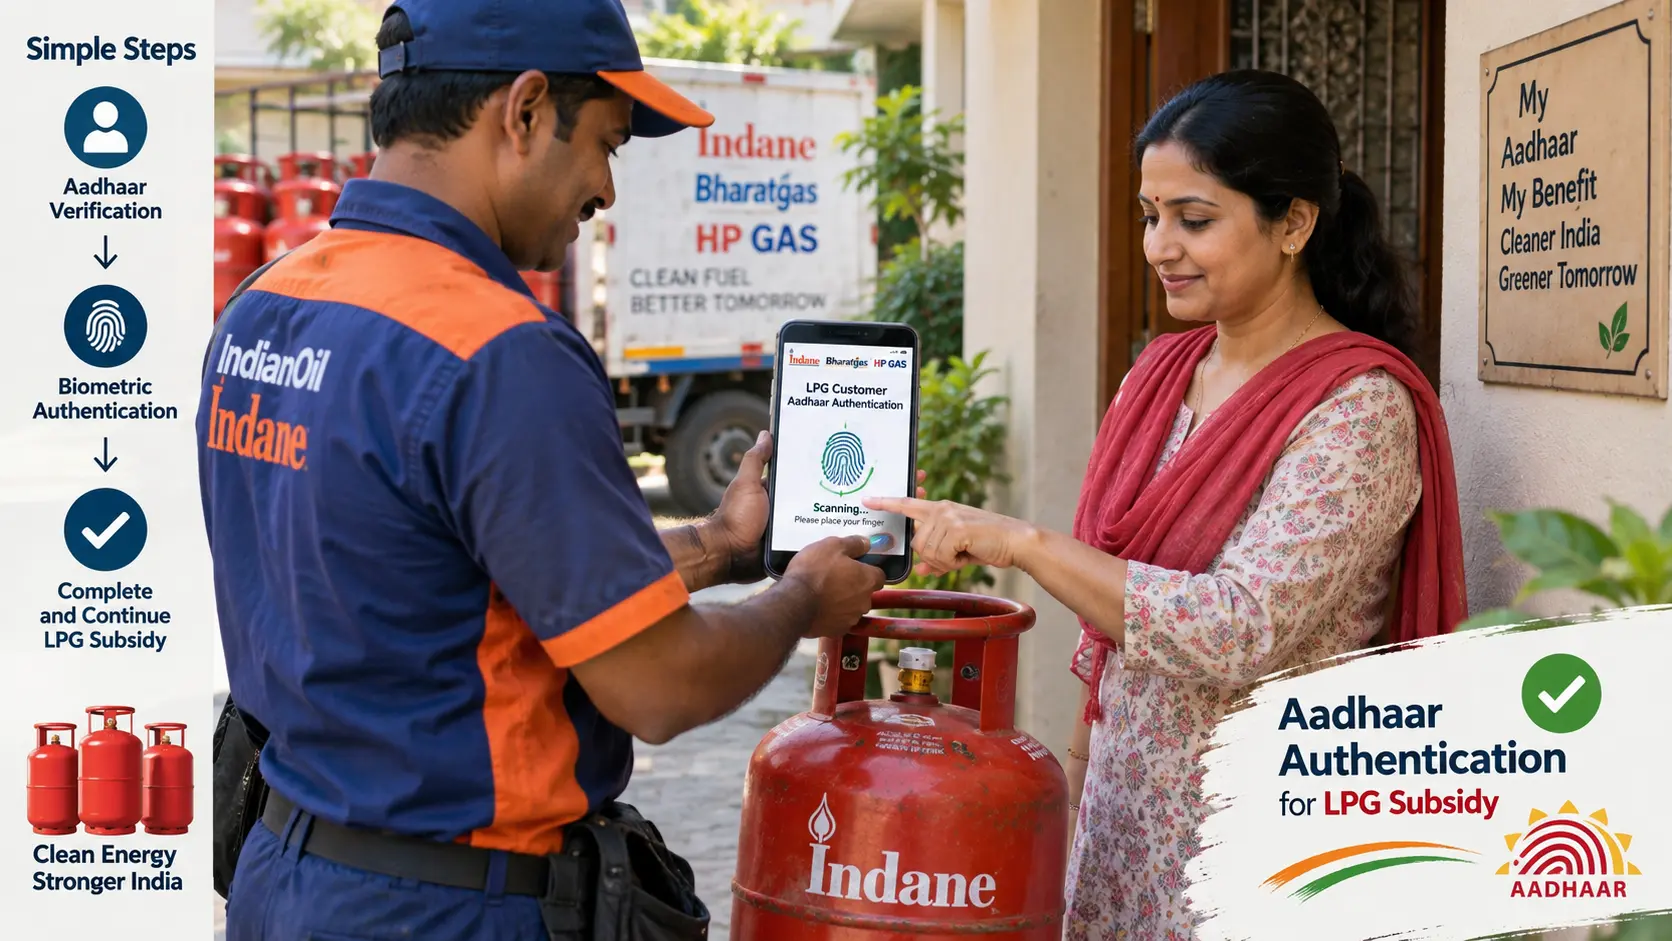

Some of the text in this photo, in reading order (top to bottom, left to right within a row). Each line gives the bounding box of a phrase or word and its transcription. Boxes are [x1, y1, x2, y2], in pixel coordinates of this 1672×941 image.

[1518, 79, 1549, 123] My
[697, 122, 816, 160] Indane
[1501, 129, 1578, 169] Aadhaar
[695, 172, 818, 211] Bharatgas
[1501, 168, 1598, 220] My Benefit
[697, 224, 819, 254] HP GAS
[1500, 217, 1601, 255] Cleaner India
[630, 268, 750, 289] CLEAN FUEL
[1499, 262, 1638, 291] Greener Tomorrow
[630, 292, 827, 315] BETTER TOMORROW
[216, 333, 332, 392] IndianOil
[789, 354, 820, 365] Indane
[874, 358, 887, 368] HP
[888, 359, 907, 369] GAS
[787, 396, 904, 411] Aadhaar Authentication
[806, 382, 887, 396] LPG Customer
[207, 385, 307, 470] Indane
[794, 515, 819, 524] Please
[820, 516, 841, 526] place
[843, 518, 860, 527] your
[813, 502, 869, 515] Scanning...
[805, 842, 997, 908] Indane
